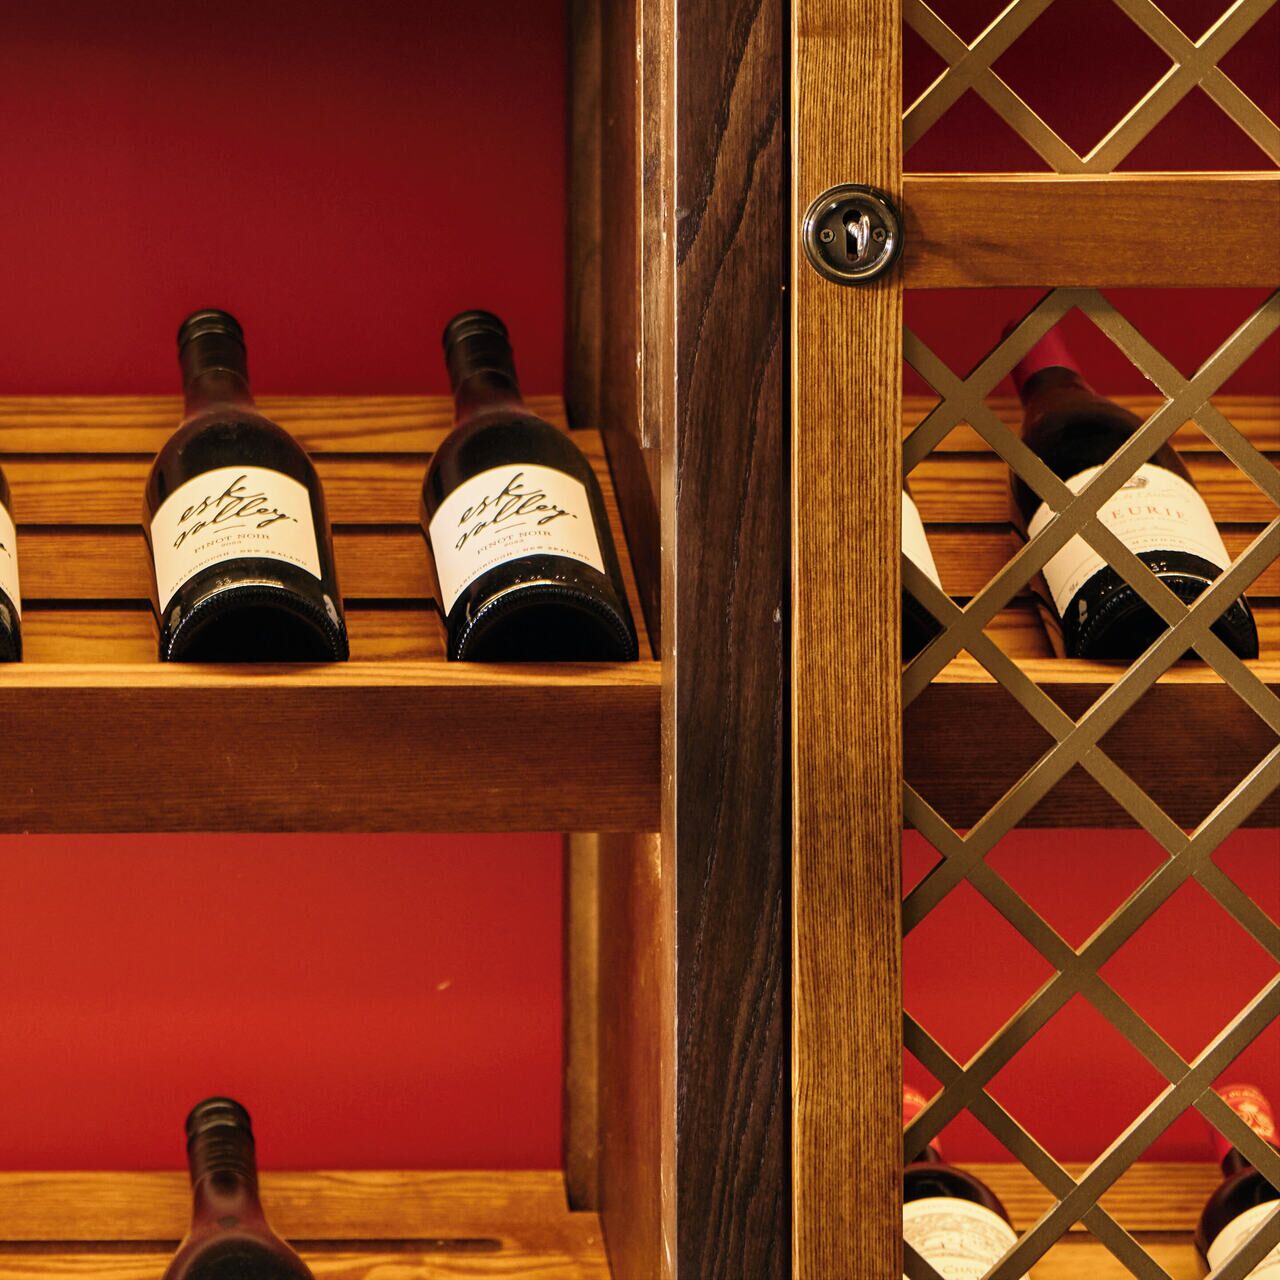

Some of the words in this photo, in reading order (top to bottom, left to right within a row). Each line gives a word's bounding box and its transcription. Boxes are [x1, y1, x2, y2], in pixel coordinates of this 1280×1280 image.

[177, 474, 265, 526] esk
[458, 472, 543, 527] esk
[194, 535, 233, 555] PINOT
[477, 535, 516, 555] PINOT
